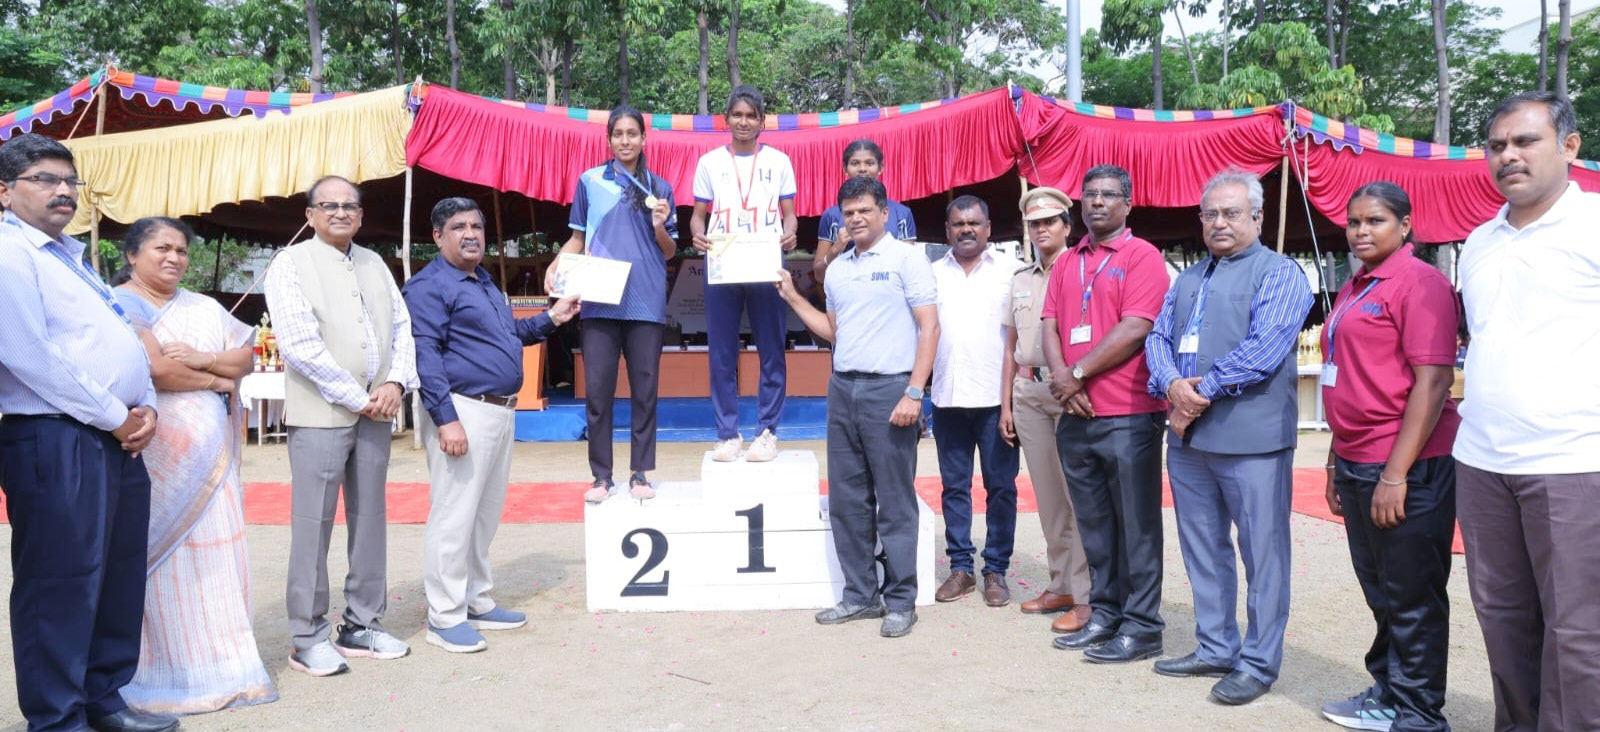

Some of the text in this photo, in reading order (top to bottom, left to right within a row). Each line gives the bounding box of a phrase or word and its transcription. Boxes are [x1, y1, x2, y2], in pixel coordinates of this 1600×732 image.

[759, 168, 772, 184] 14
[871, 271, 890, 281] SONA
[735, 503, 776, 574] 1
[620, 527, 670, 597] 2
